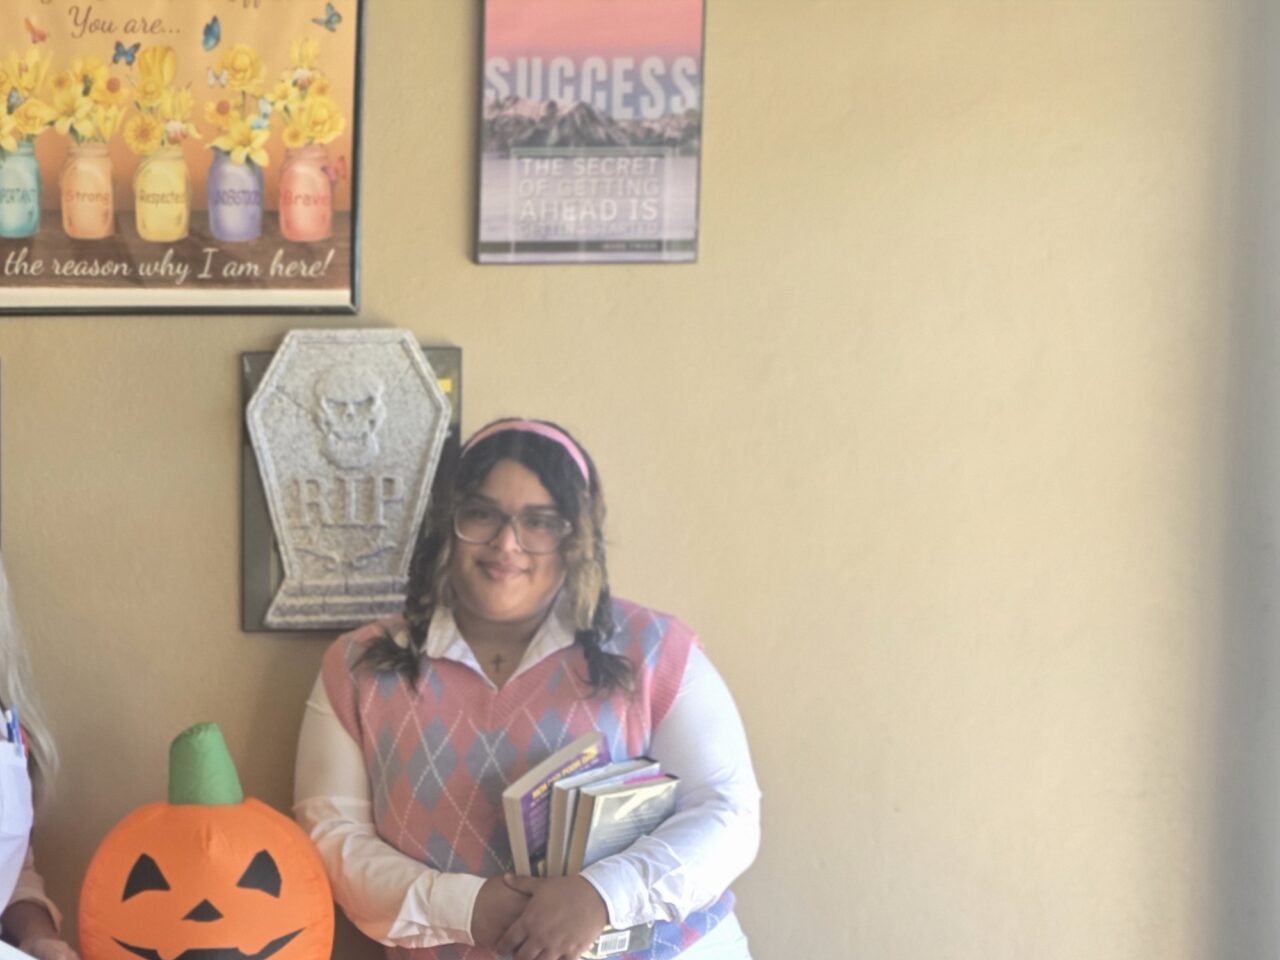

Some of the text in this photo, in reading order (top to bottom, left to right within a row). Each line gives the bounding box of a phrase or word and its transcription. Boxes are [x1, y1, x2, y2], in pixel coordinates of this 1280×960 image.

[68, 5, 181, 38] You are...
[486, 55, 699, 120] SUCCESS
[522, 157, 658, 176] THE SECRET
[66, 189, 110, 206] Strong
[520, 178, 659, 197] OF GETTING
[520, 198, 658, 221] AHEAD IS
[4, 247, 45, 276] the
[52, 259, 132, 276] reason
[138, 248, 192, 285] why
[198, 248, 219, 279] I
[222, 260, 262, 277] am
[270, 248, 335, 278] here!
[292, 476, 405, 527] RIP
